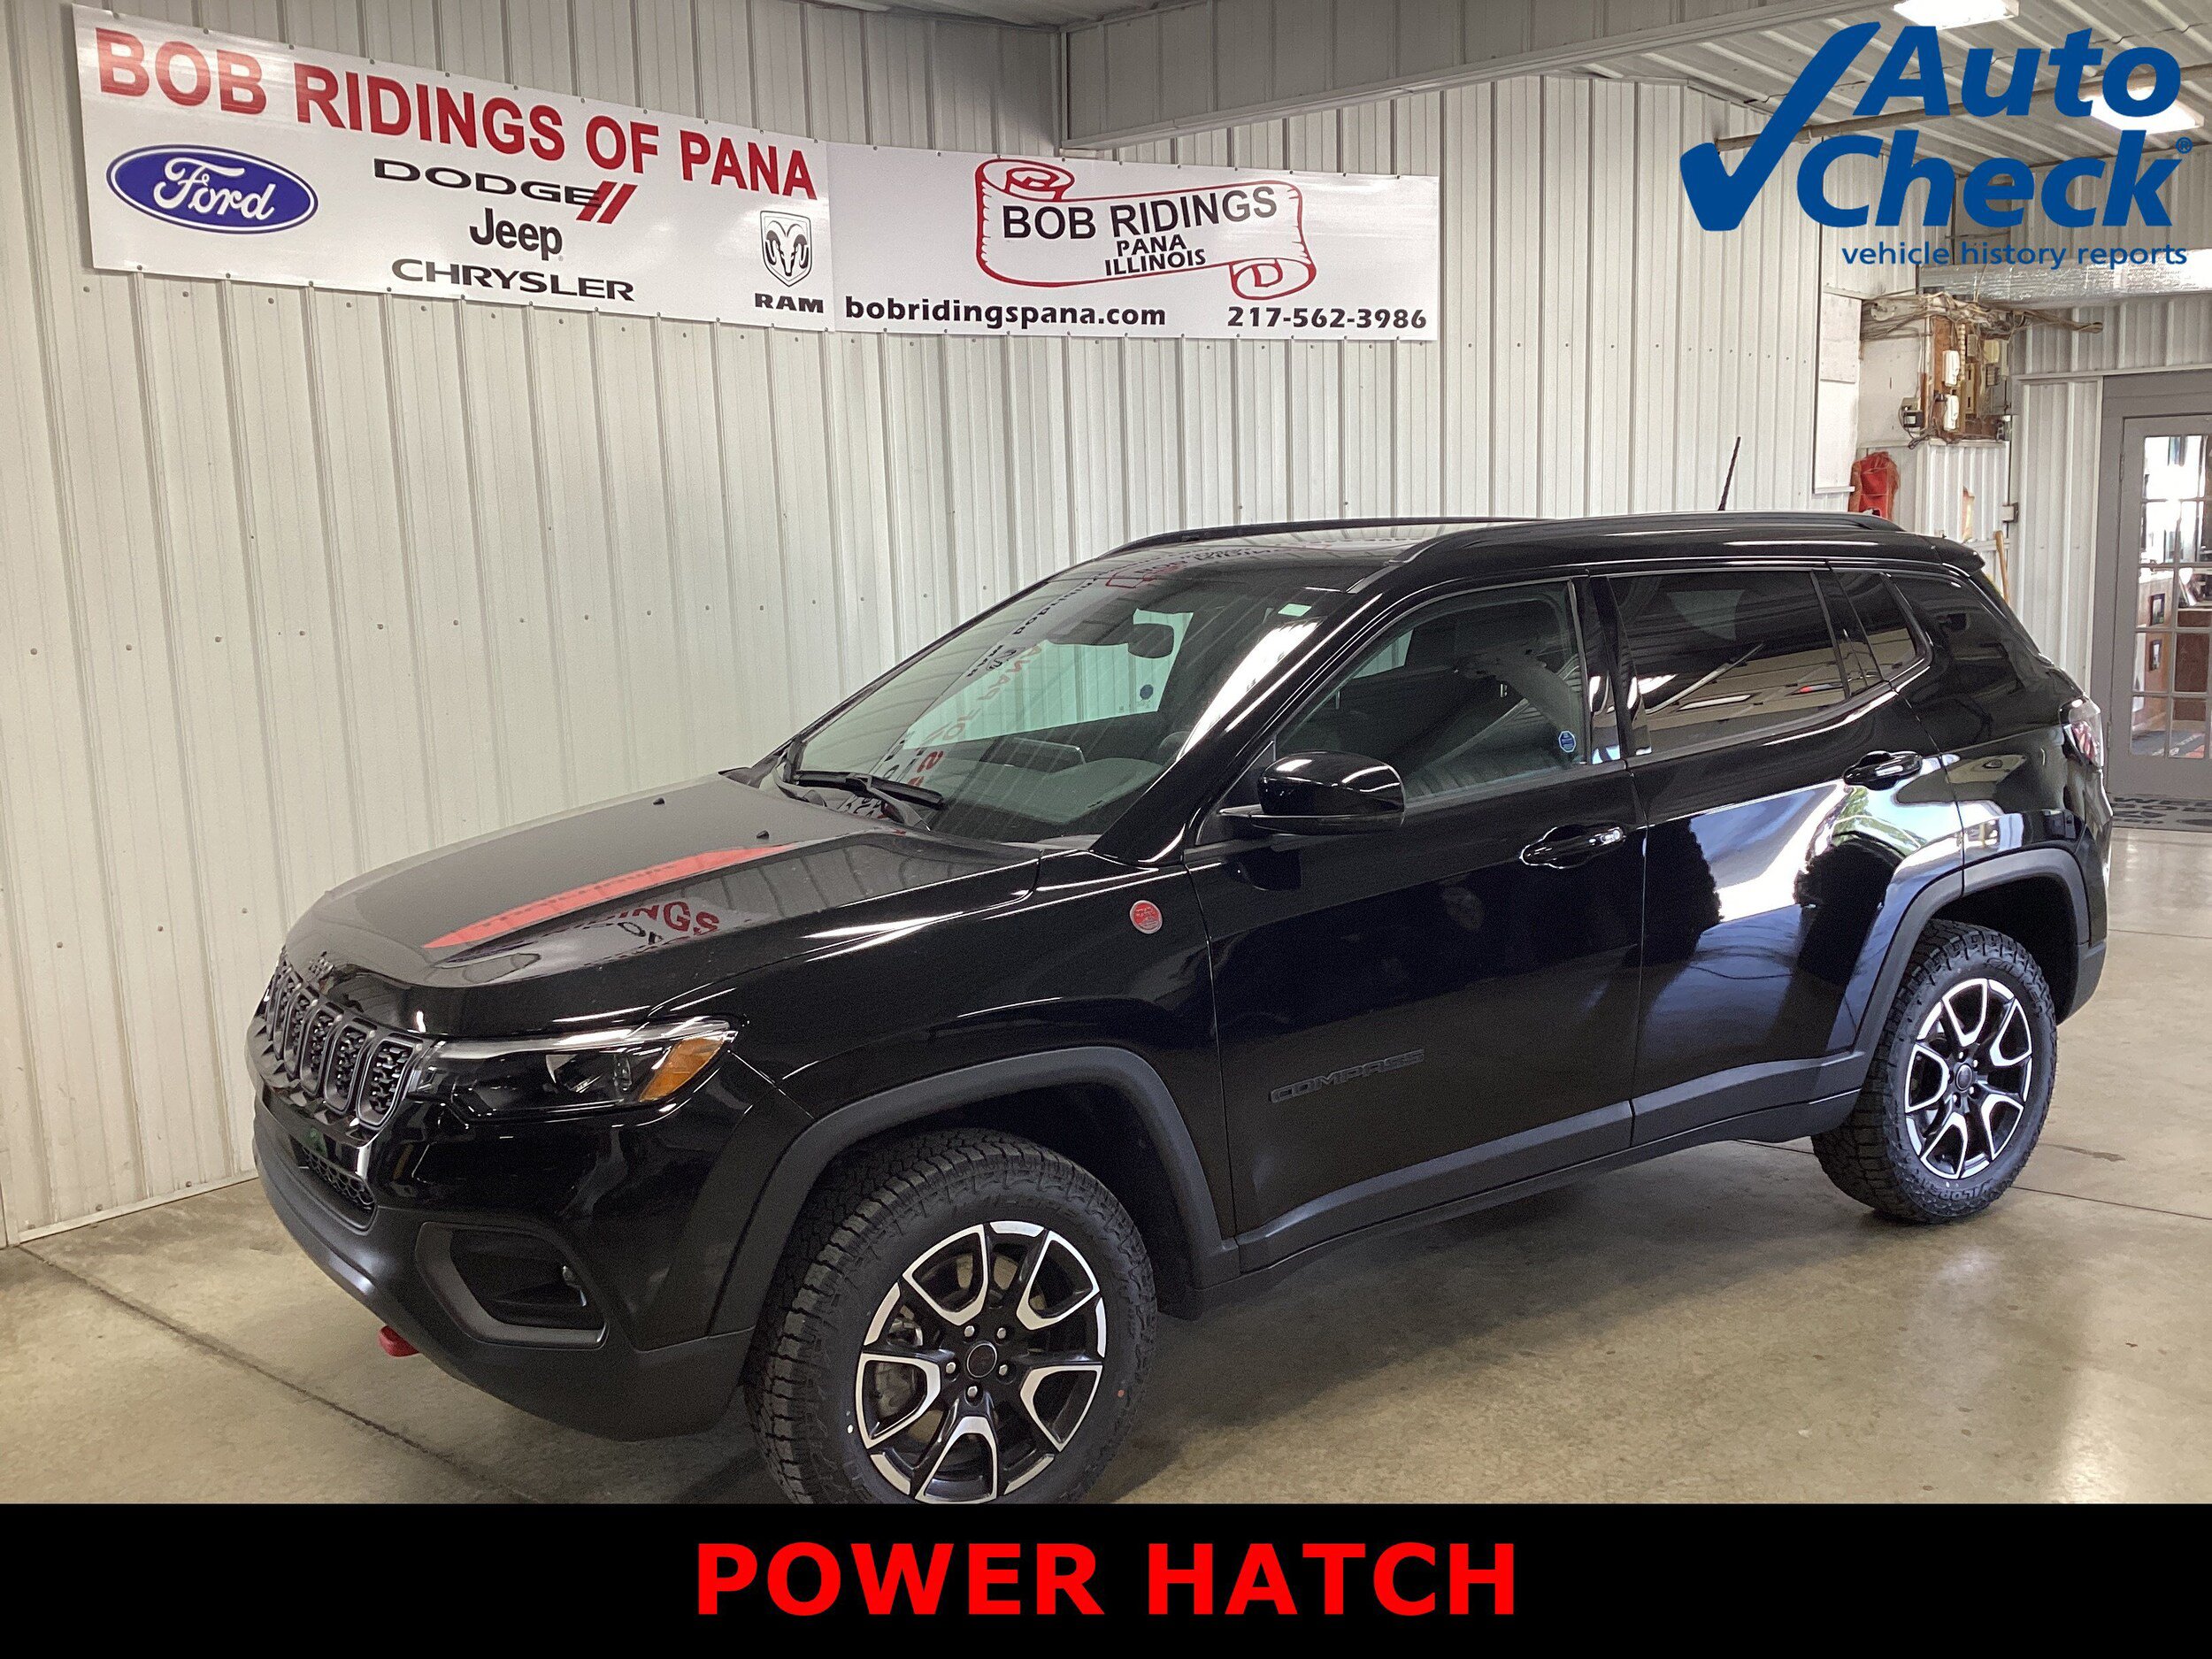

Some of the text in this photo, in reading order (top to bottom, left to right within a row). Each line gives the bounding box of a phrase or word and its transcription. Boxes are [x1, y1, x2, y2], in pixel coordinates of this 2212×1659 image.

[96, 28, 817, 200] BOB RIDINGS OF PANA
[153, 157, 275, 220] Ford
[374, 158, 602, 209] DODGE
[470, 208, 563, 261] Jeep
[1003, 187, 1278, 240] BOB RIDINGS
[1104, 249, 1206, 276] ILLINOIS
[1117, 234, 1187, 257] PANA
[392, 258, 634, 302] CHRYSLER
[755, 293, 824, 313] RAM
[846, 296, 1165, 330] bobridingspana.com
[1228, 307, 1426, 329] 217-562-3986
